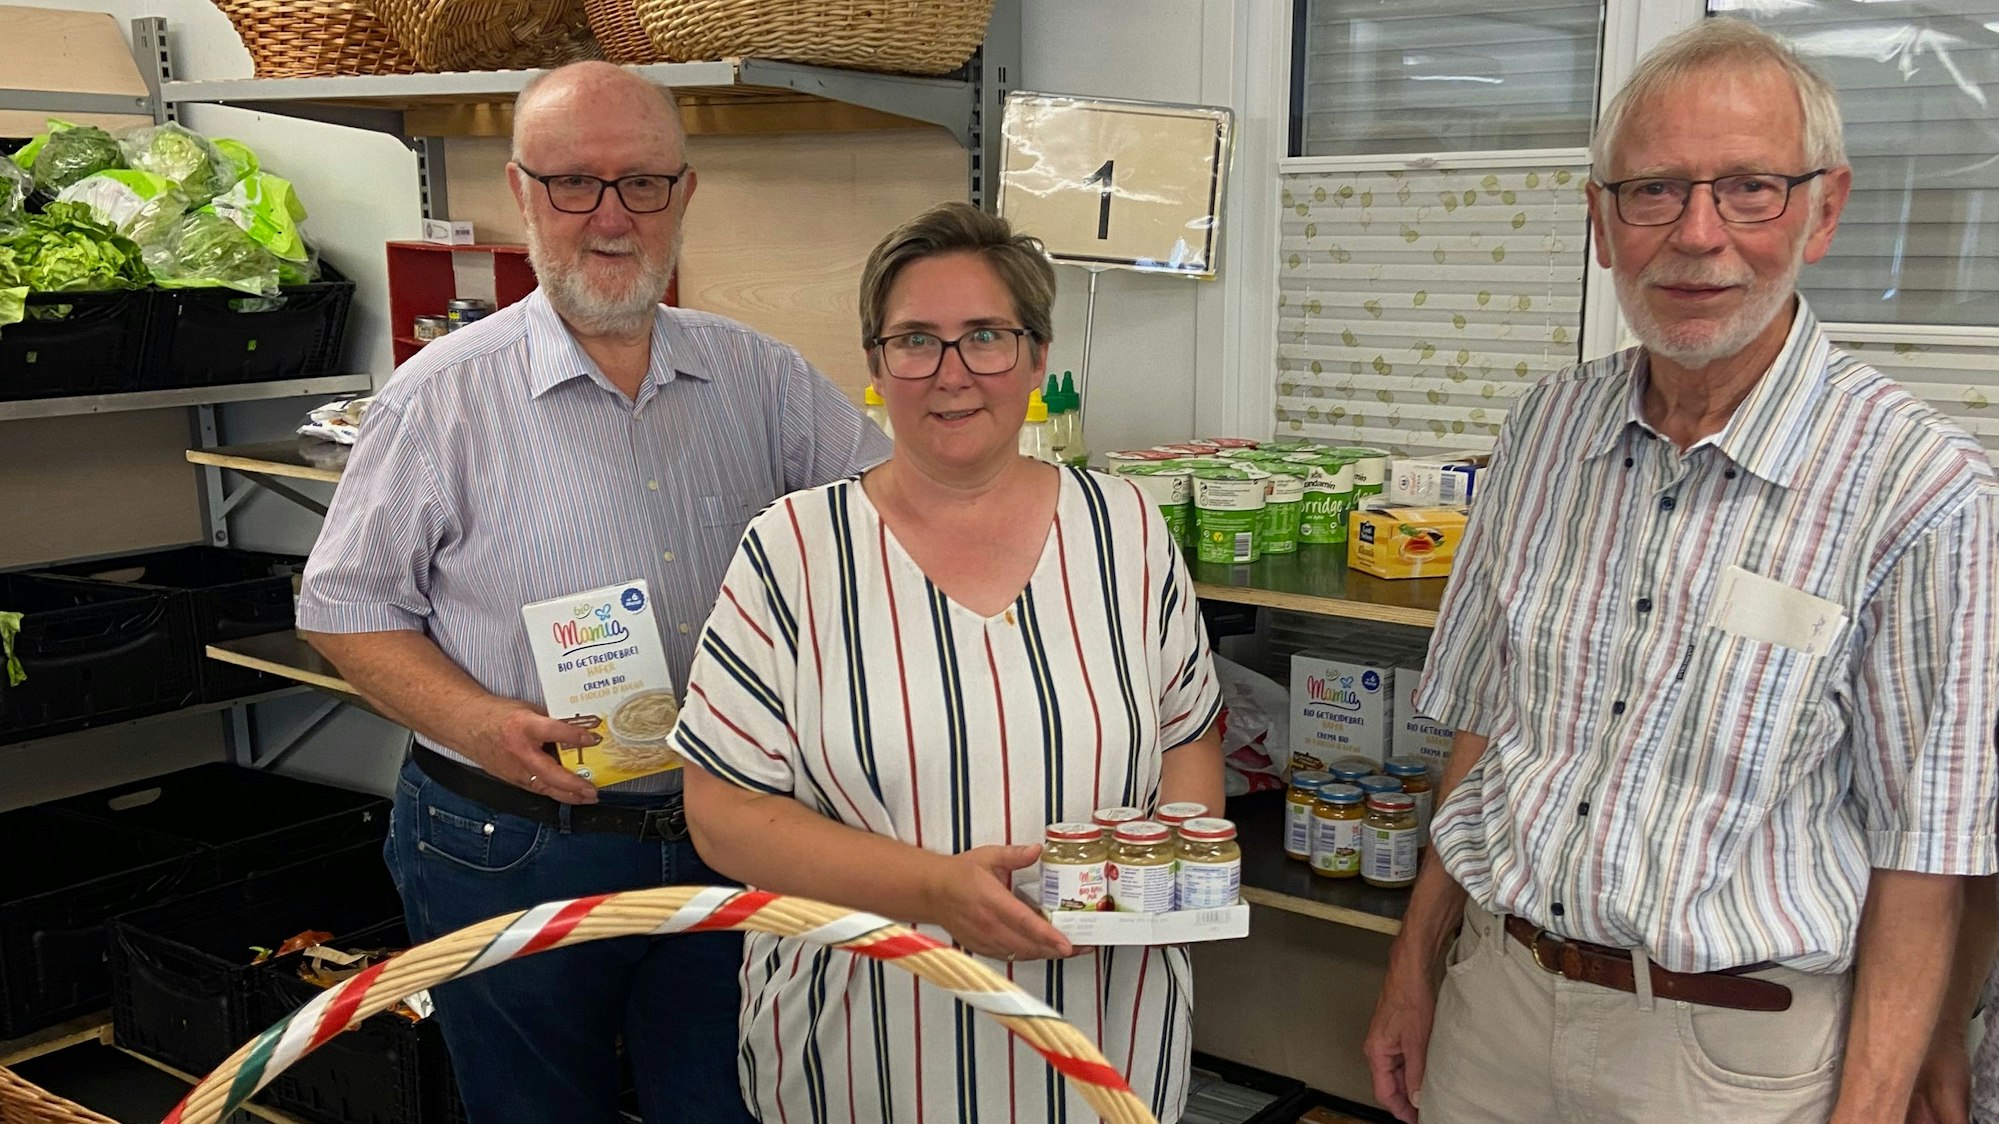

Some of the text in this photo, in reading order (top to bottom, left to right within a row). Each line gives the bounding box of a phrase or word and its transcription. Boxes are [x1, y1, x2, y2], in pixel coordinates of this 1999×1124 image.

[1083, 160, 1114, 240] 1
[573, 603, 591, 617] bio
[552, 619, 630, 649] Mamia
[557, 645, 640, 673] BIO GETREIDEBREI
[583, 674, 626, 692] CREMA BIO
[1307, 675, 1361, 705] Mamia
